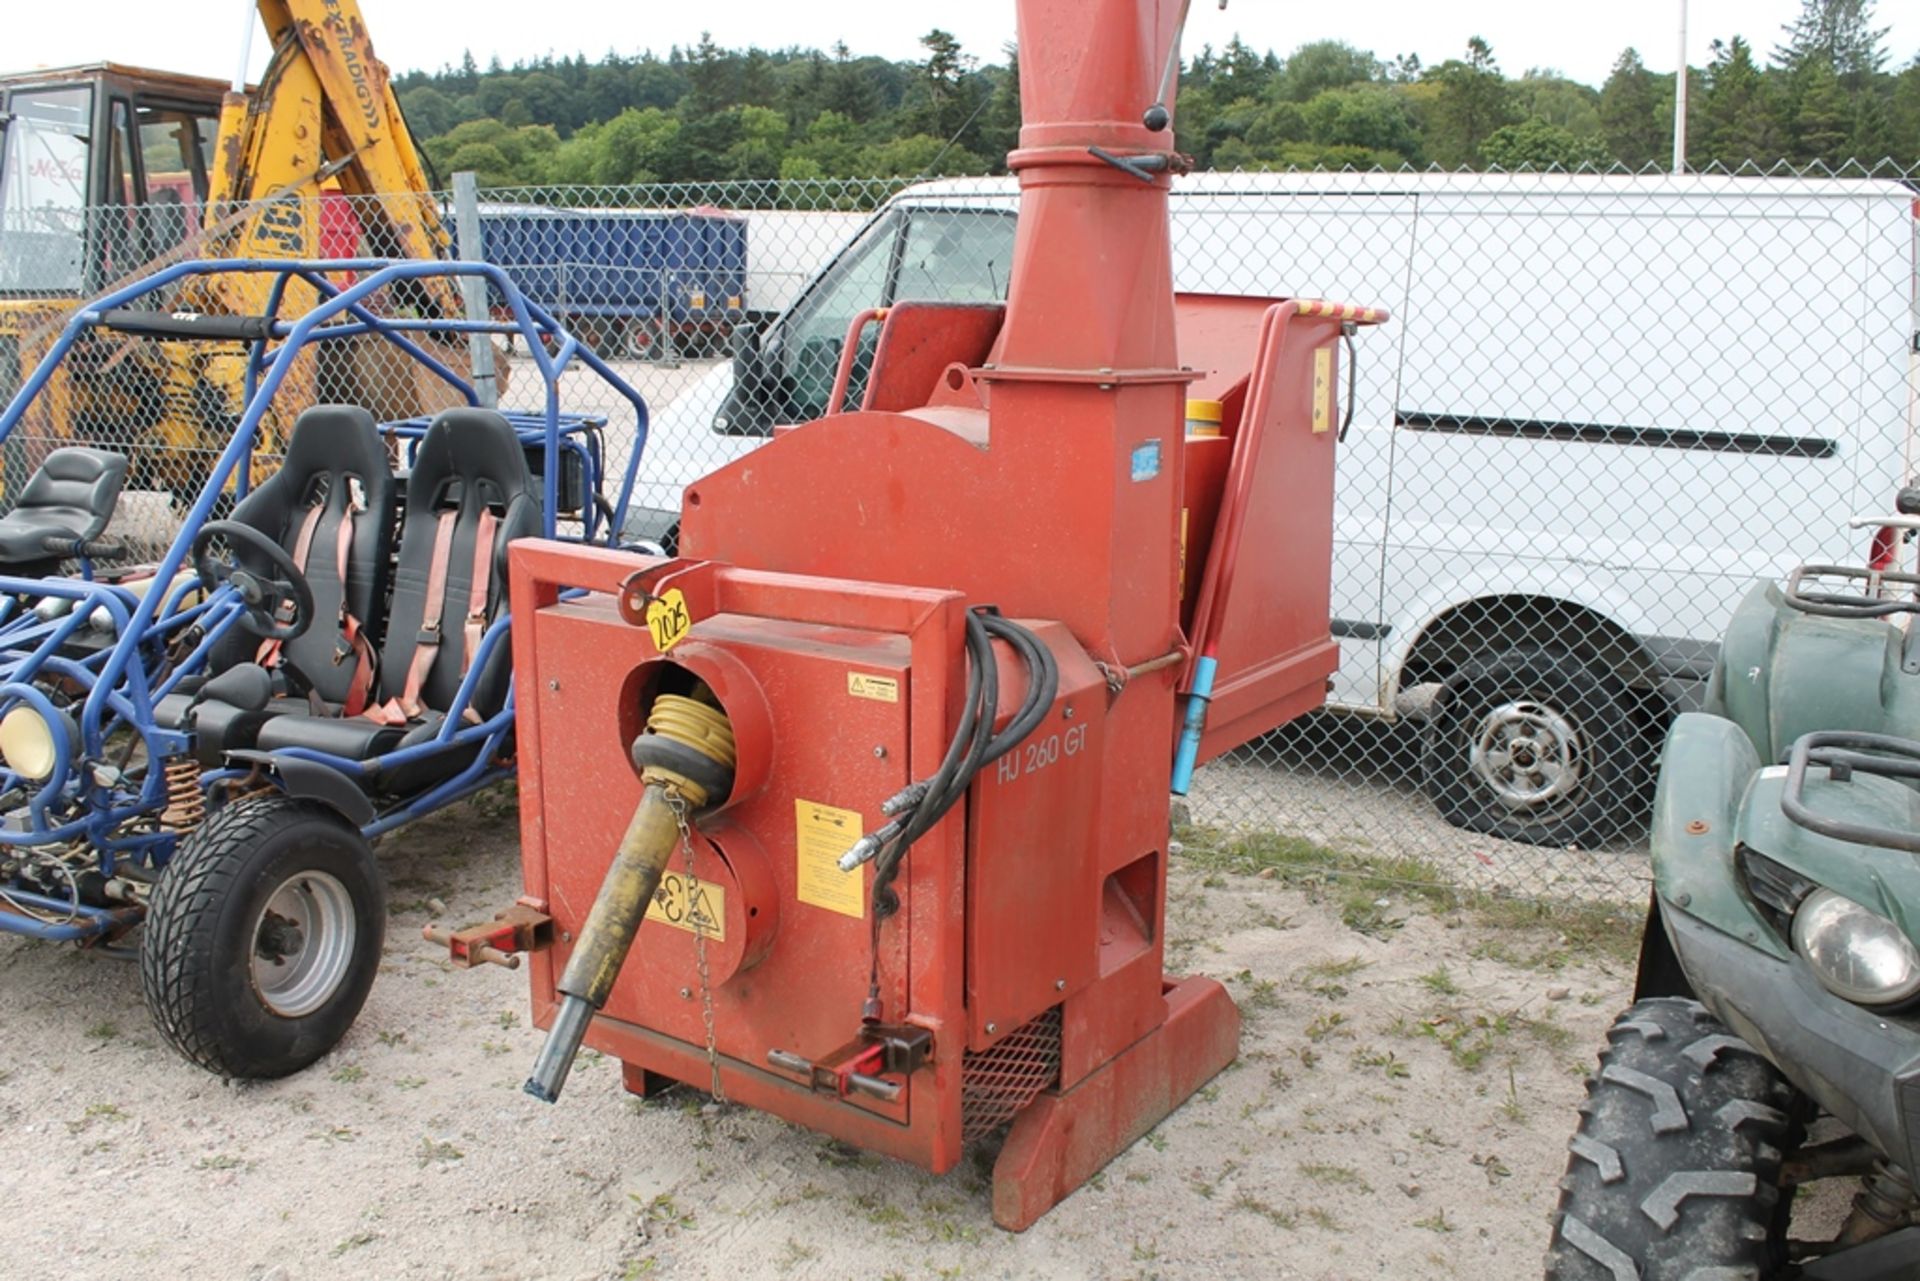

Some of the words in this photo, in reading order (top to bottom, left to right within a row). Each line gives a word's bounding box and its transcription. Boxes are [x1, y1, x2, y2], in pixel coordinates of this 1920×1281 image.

[256, 192, 302, 252] JCB
[650, 601, 687, 649] 2025
[997, 750, 1021, 784] HJ
[1025, 735, 1059, 774] 260
[1064, 723, 1088, 756] GT
